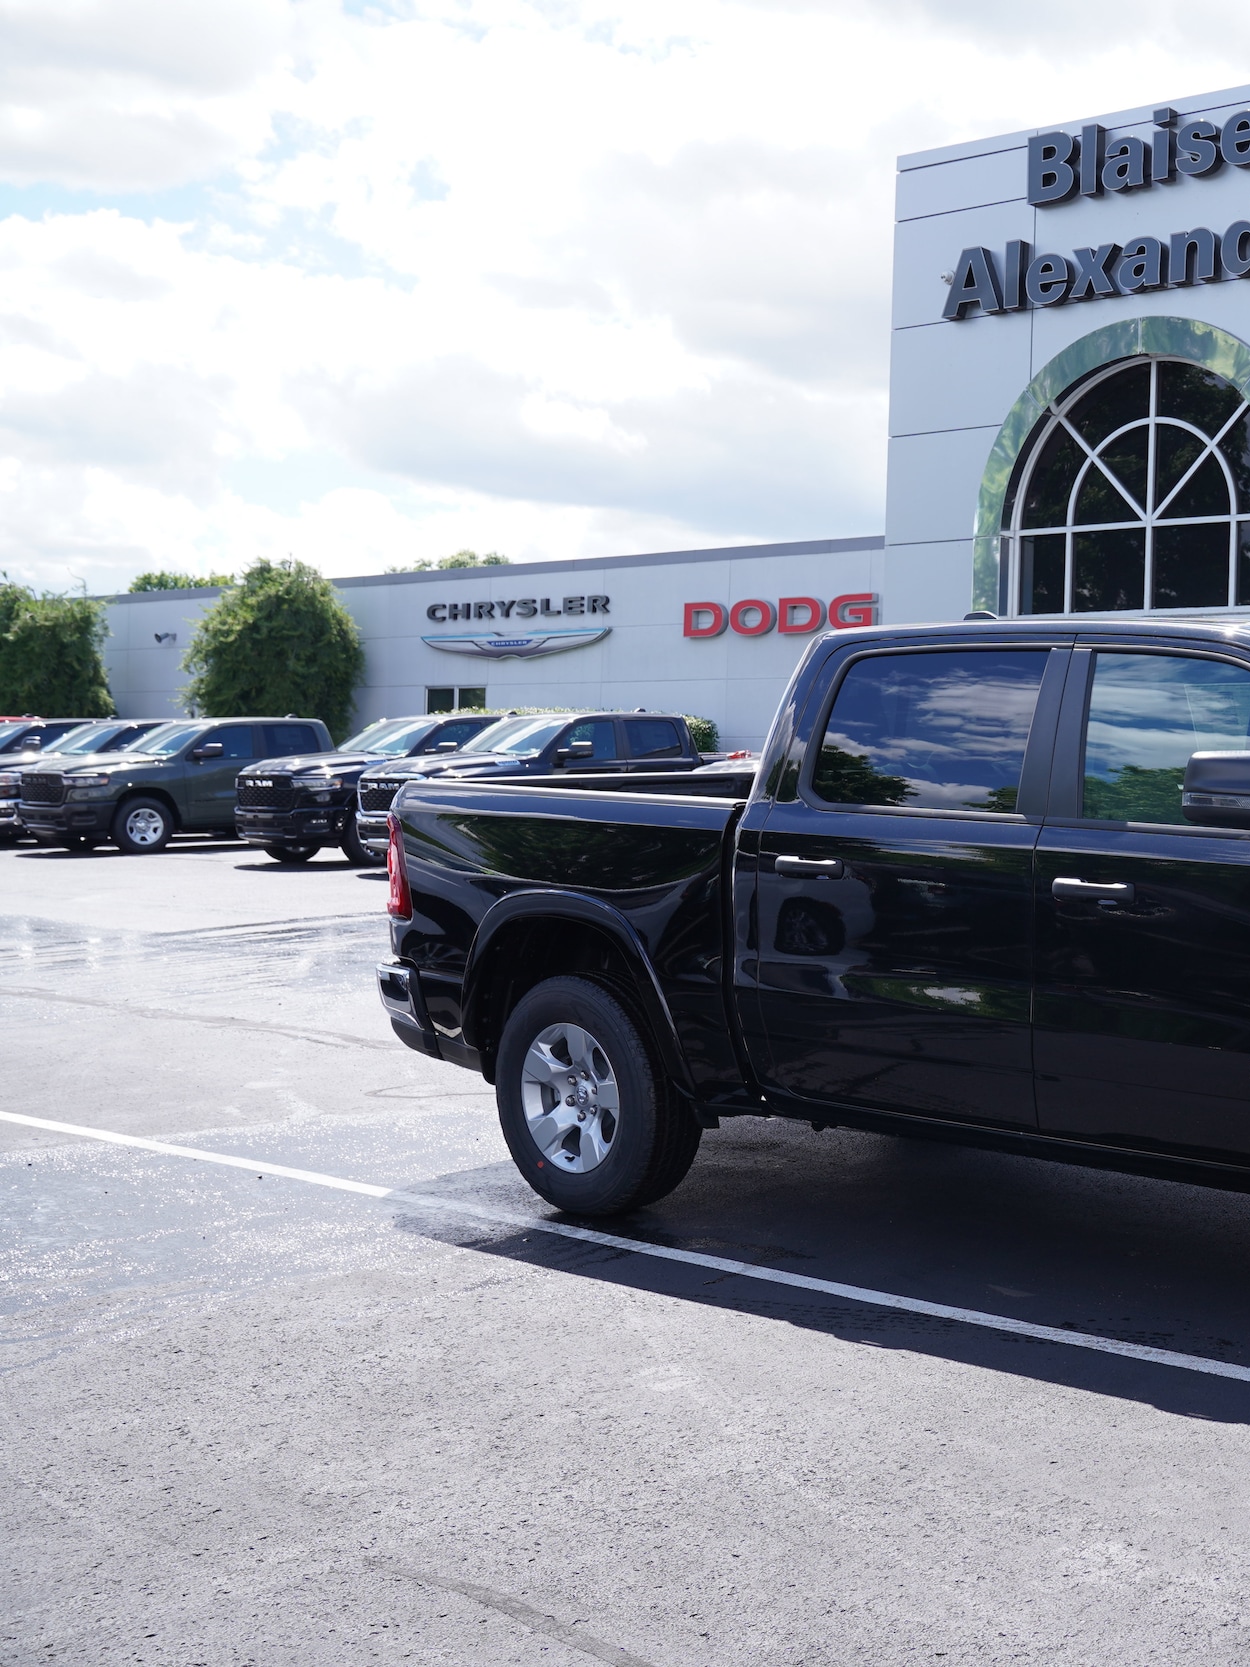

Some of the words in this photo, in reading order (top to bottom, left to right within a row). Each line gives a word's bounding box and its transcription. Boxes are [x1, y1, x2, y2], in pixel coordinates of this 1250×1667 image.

[426, 595, 611, 622] CHRYSLER
[245, 779, 274, 788] RAM
[368, 782, 399, 791] RAM
